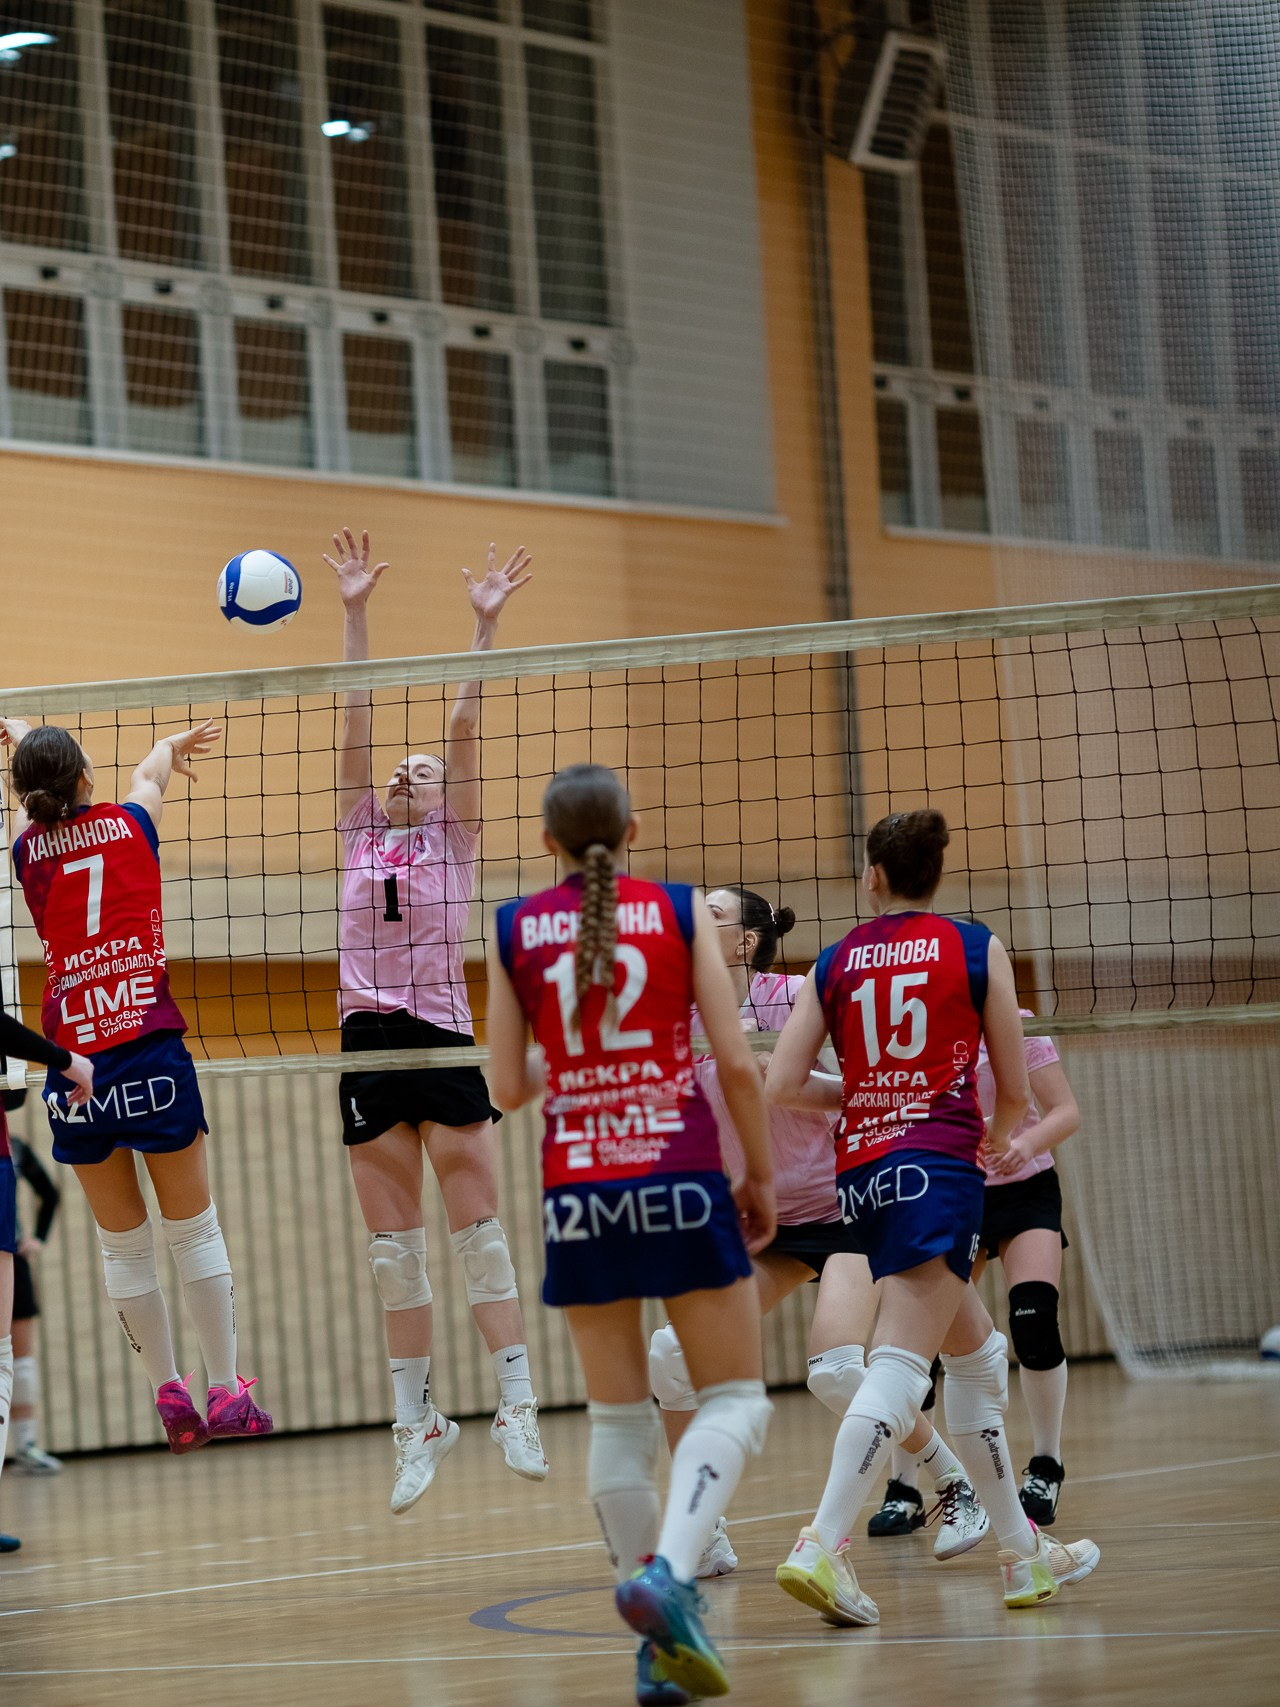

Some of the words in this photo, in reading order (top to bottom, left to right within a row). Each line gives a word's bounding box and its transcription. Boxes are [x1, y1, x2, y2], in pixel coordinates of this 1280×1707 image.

[27, 817, 133, 864] ХАННАНОВА
[62, 853, 105, 938] 7
[383, 874, 403, 922] 1
[521, 901, 664, 951] ВАСИНА
[60, 963, 110, 991] САМАРСКАЯ
[112, 953, 154, 975] ОБЛАСТЬ
[63, 936, 143, 971] ИСКРА
[844, 938, 940, 973] ЛЕОНОВА
[99, 1008, 147, 1029] GLOBAL
[543, 943, 654, 1058] 12
[851, 971, 929, 1068] 15
[102, 1018, 144, 1038] VISION
[859, 1071, 929, 1087] СКРА
[865, 1121, 916, 1137] GLOBAL
[865, 1128, 907, 1148] VISION
[837, 1164, 930, 1225] 2MED
[988, 1441, 1005, 1480] adrenalina
